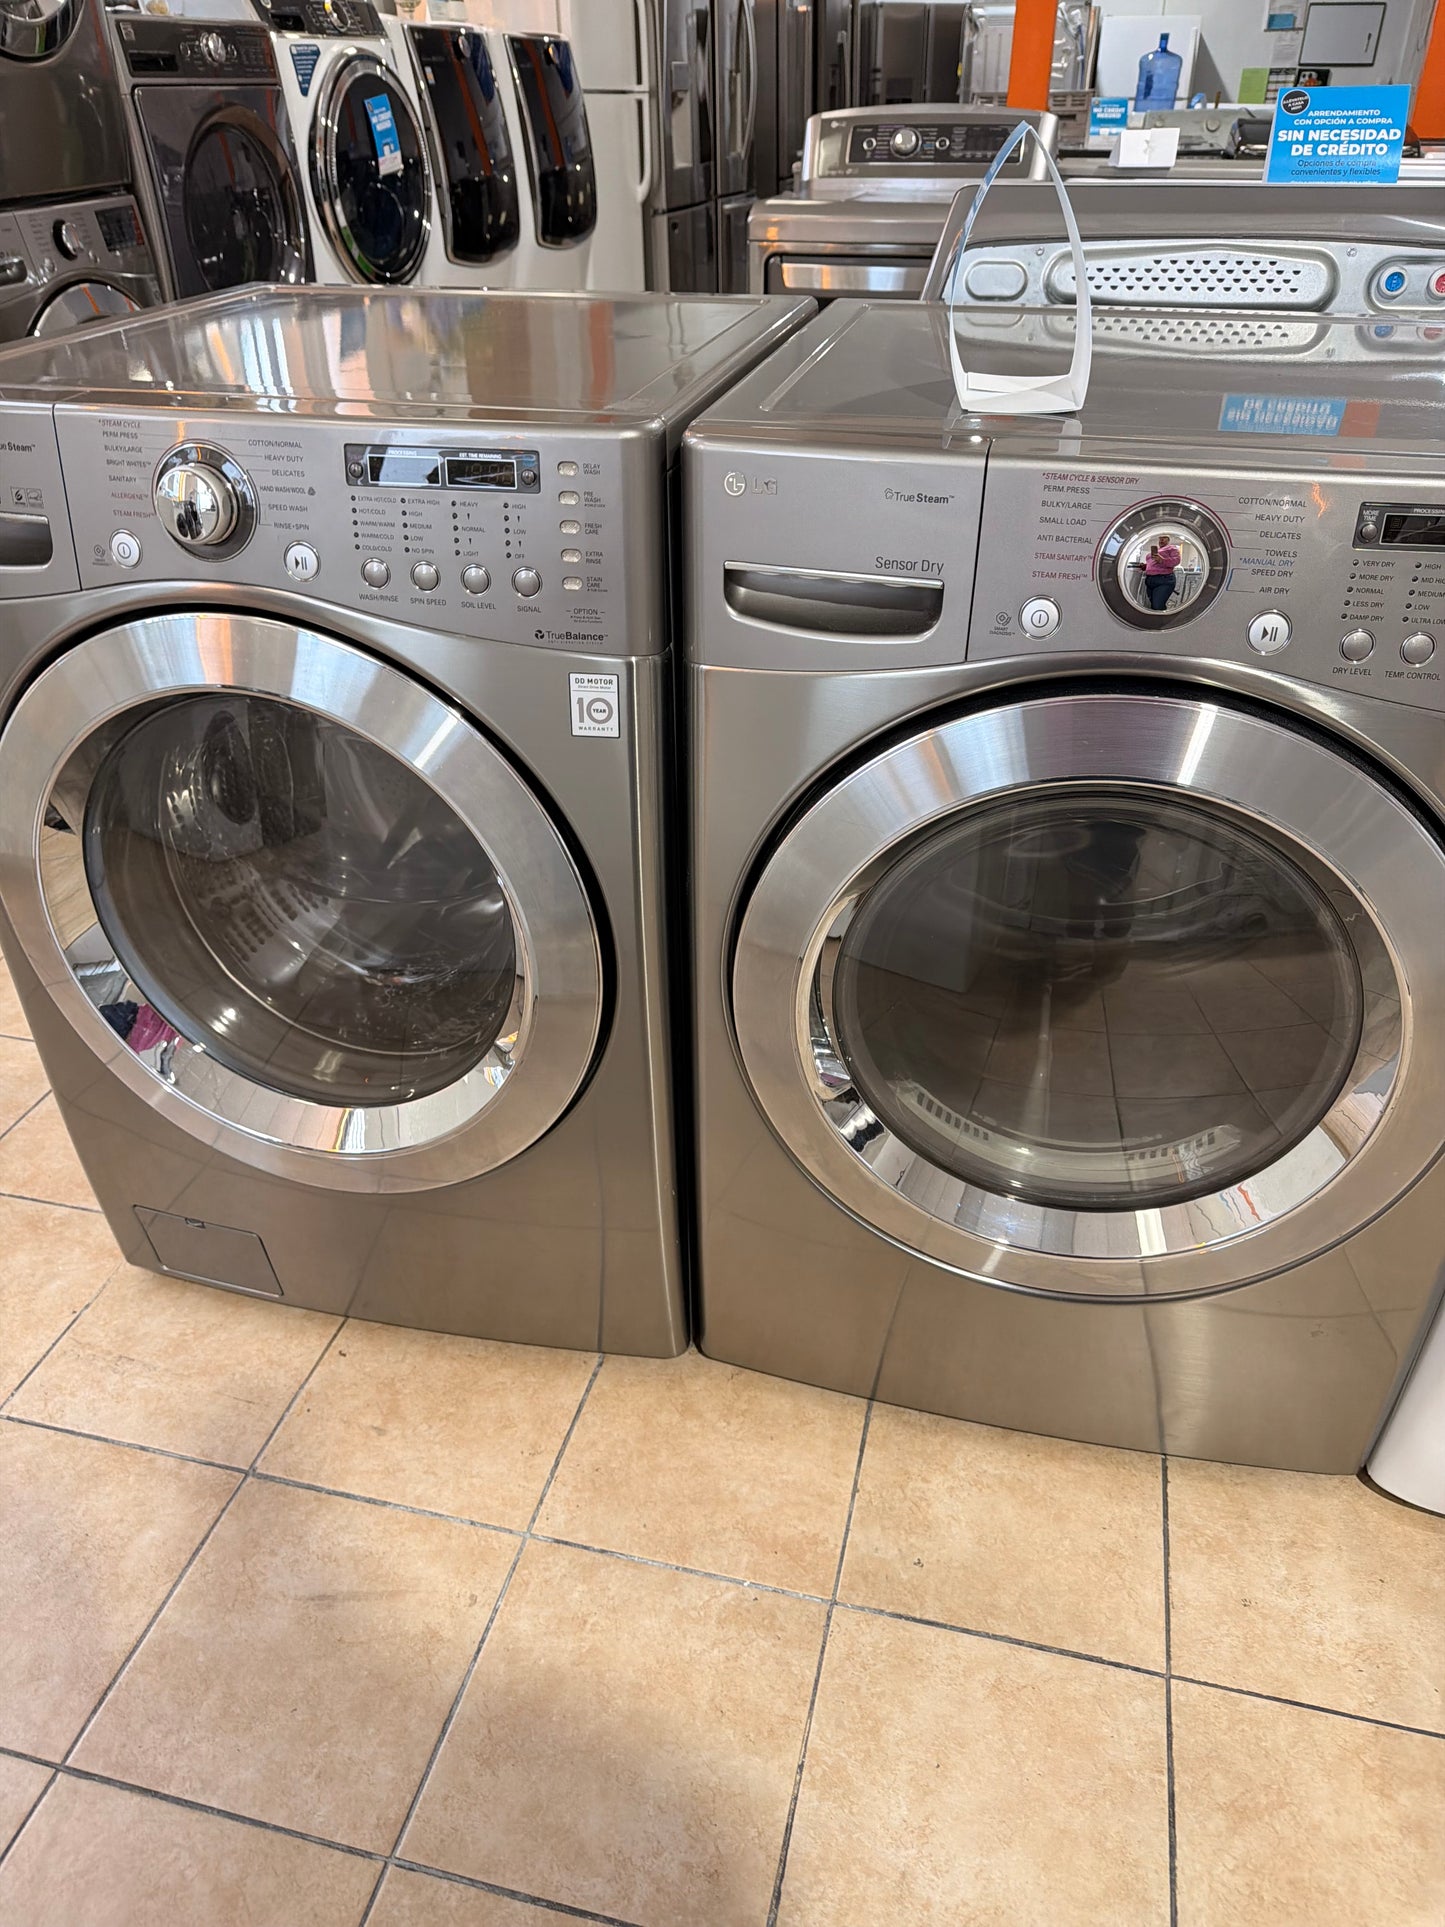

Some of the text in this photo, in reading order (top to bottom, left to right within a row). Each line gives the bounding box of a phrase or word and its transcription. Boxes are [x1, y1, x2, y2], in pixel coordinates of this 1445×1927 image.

[1308, 109, 1381, 117] ARRENDAMIENTO
[1278, 129, 1401, 141] SIN NECESIDAD
[1291, 144, 1313, 156] DE
[1349, 167, 1381, 175] flexibles
[123, 421, 141, 429] CYCLE
[248, 439, 303, 449] COTTON/NORMAL
[104, 445, 143, 453] BULKY/LARGE
[106, 459, 125, 467] BRIGHT
[264, 454, 303, 463] HEAVY DUTY
[271, 469, 305, 478] DELICATES
[108, 475, 137, 483] SANITARY
[1070, 474, 1089, 483] CYCLE
[1089, 475, 1096, 483] &
[1097, 475, 1123, 484] SENSOR
[1124, 476, 1140, 485] DRY
[259, 485, 306, 494] HAND WASH/WOOL
[751, 476, 778, 495] LG
[1067, 486, 1090, 495] PRESS
[1041, 500, 1092, 511] BULKY/LARGE
[1238, 496, 1307, 508] COTTON/NORMAL
[268, 504, 308, 513] SPEED WASH
[113, 510, 132, 518] STEAM
[1039, 516, 1087, 526] SMALL LOAD
[1255, 514, 1306, 524] HEAVY DUTY
[360, 520, 395, 528] WARM/WARM
[410, 522, 432, 530] MEDIUM
[1037, 534, 1093, 545] ANTI BACTERIAL
[1259, 531, 1302, 541] DELICATES
[362, 544, 392, 552] COLD/COLD
[1034, 552, 1056, 562] STEAM
[1265, 549, 1298, 559] TOWELS
[875, 556, 945, 575] Sensor Dry
[1277, 558, 1295, 568] DRY
[1032, 571, 1055, 580] STEAM
[1251, 568, 1294, 579] SPEED DRY
[1259, 586, 1290, 595] AIR DRY
[1356, 587, 1384, 595] NORMAL
[359, 593, 399, 603] WASH/RINSE
[410, 597, 447, 606] SPIN SPEED
[461, 601, 496, 610] SOIL LEVEL
[517, 605, 541, 613] SIGNAL
[1414, 603, 1430, 611] LOW
[574, 608, 598, 616] OPTION
[1349, 614, 1370, 622] DAMP
[1332, 667, 1372, 676] DRY LEVEL
[1384, 671, 1441, 681] TEMP. CONTROL
[576, 697, 613, 724] 10
